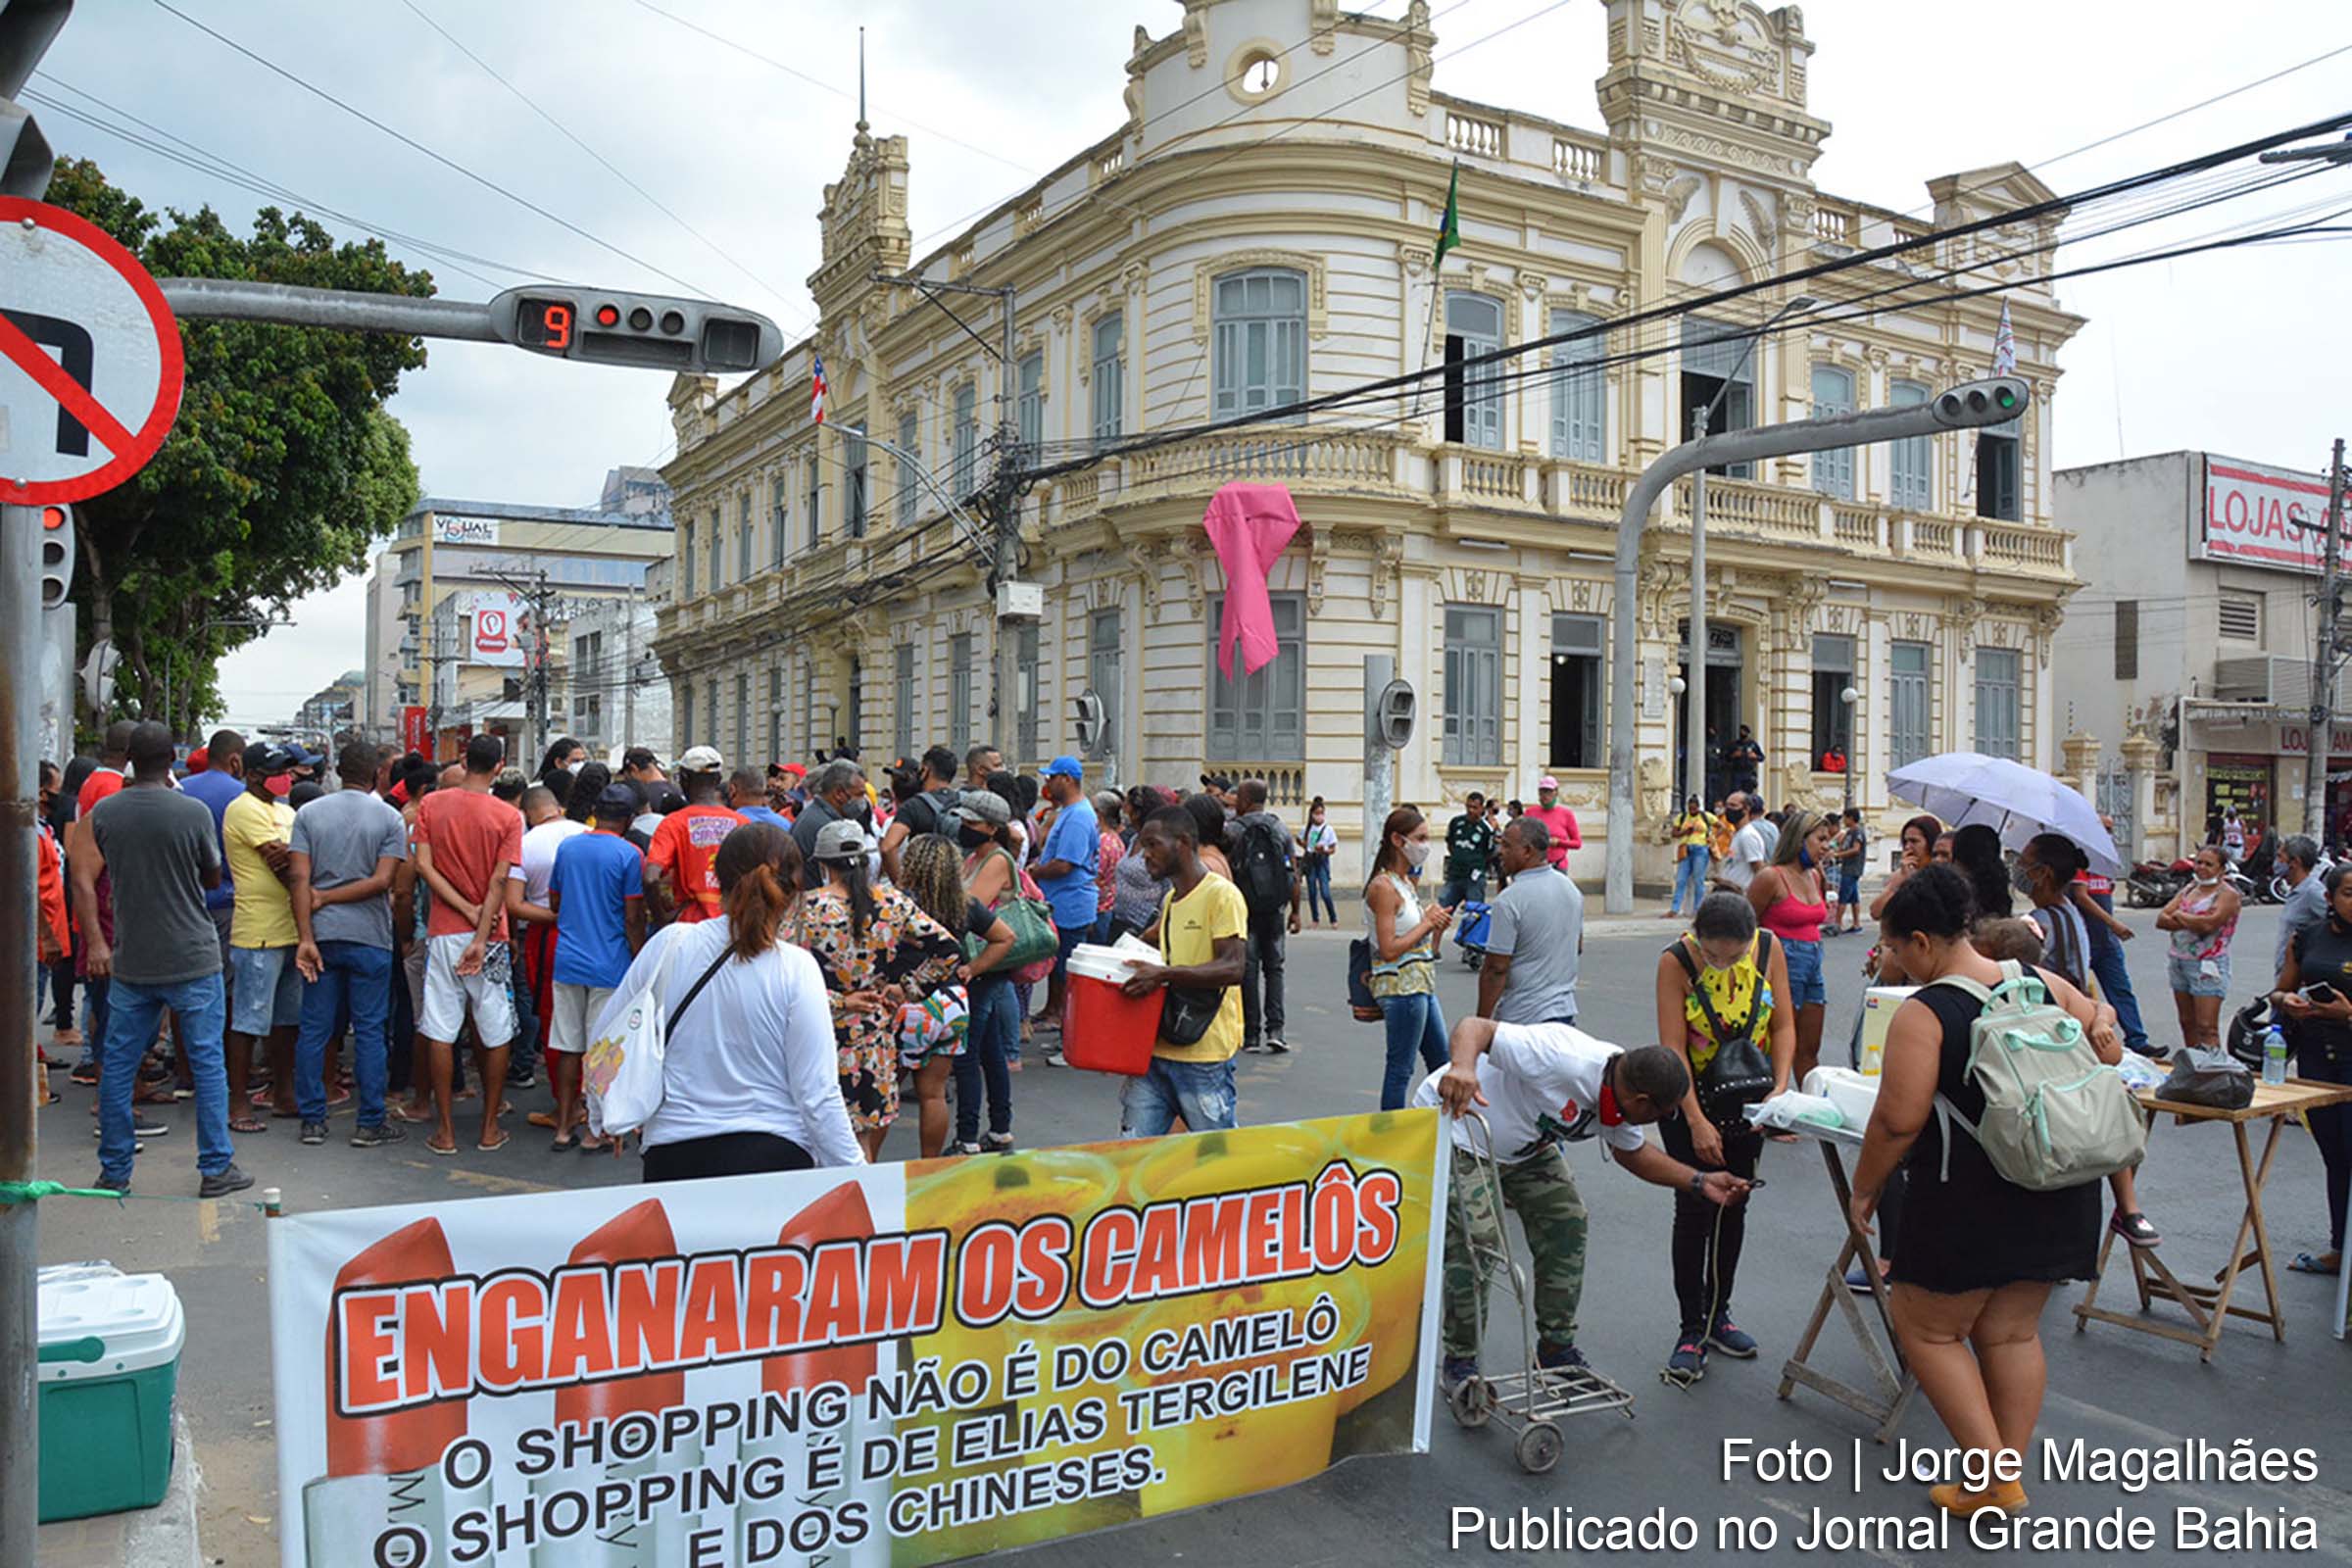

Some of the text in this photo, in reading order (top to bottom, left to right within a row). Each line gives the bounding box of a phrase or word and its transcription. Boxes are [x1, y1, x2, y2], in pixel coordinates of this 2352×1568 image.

[544, 305, 570, 349] 9
[2209, 485, 2305, 542] LOJAS
[339, 1162, 1400, 1412] ENGANARAM OS CAMELÔS
[373, 1527, 427, 1568] O
[450, 1455, 785, 1562] SHOPPING
[807, 1436, 842, 1491] É
[861, 1429, 936, 1481] DE
[955, 1399, 1105, 1464] ELIAS
[1120, 1346, 1371, 1433] TERGILENE
[445, 1440, 491, 1489] O
[515, 1386, 848, 1475] SHOPPING
[868, 1357, 989, 1420] NÃO
[1006, 1344, 1038, 1396] É
[1055, 1341, 1128, 1389] DO
[1143, 1293, 1338, 1373] CAMELÔ
[689, 1528, 723, 1568] E
[747, 1502, 869, 1563] DOS
[889, 1446, 1164, 1534] CHINESES.
